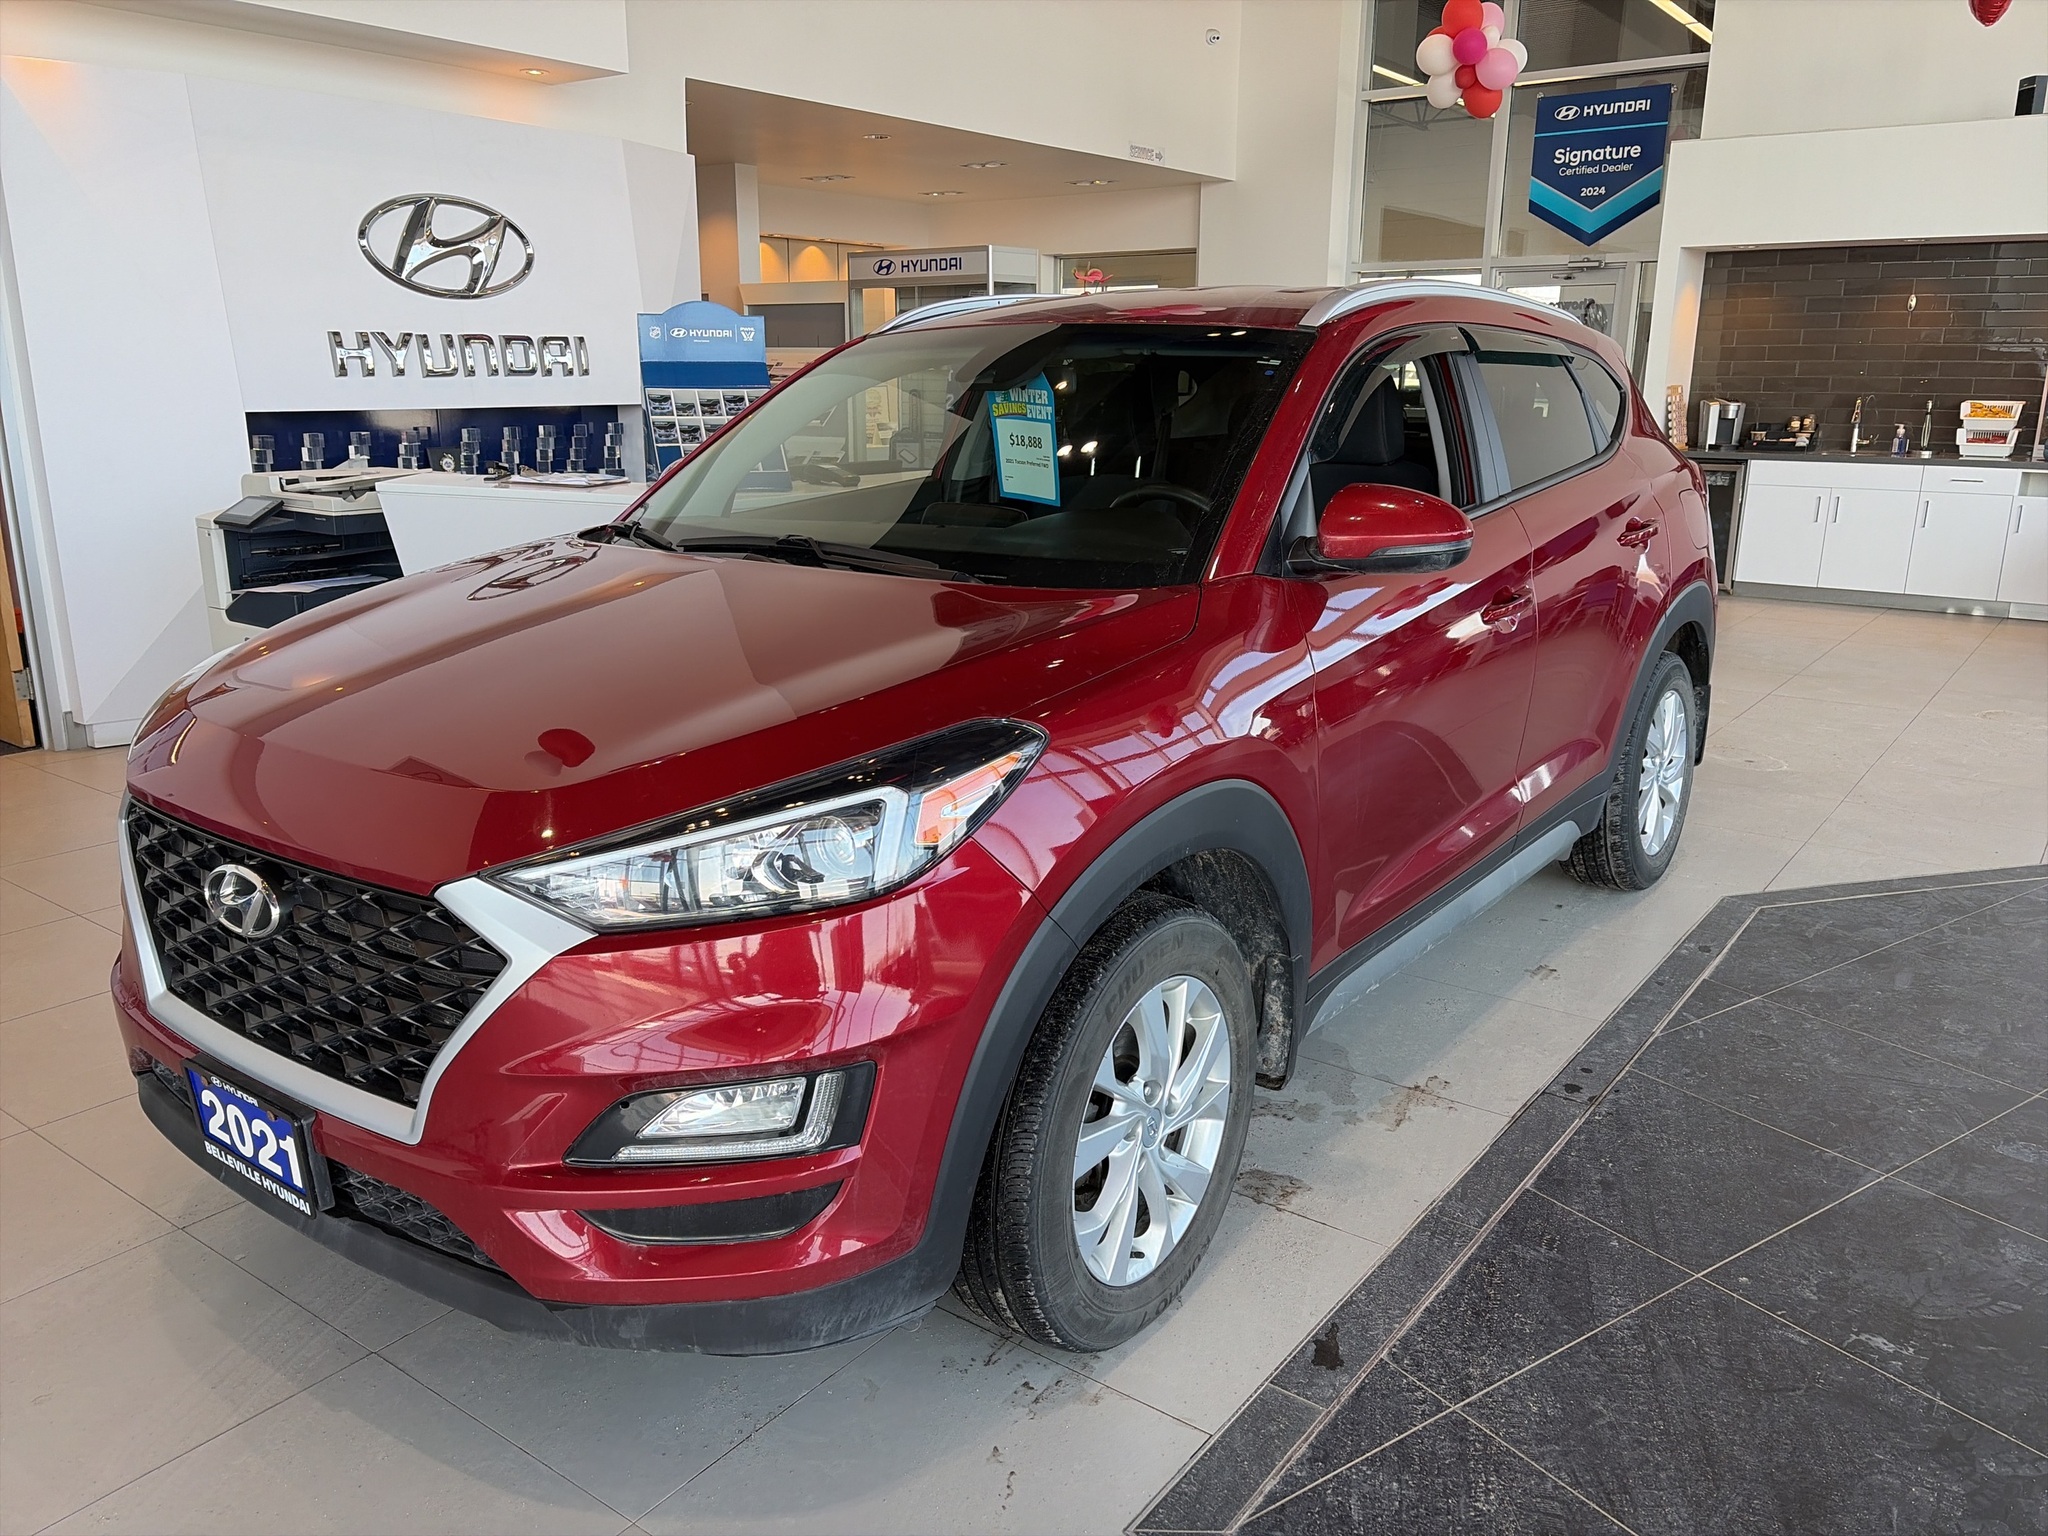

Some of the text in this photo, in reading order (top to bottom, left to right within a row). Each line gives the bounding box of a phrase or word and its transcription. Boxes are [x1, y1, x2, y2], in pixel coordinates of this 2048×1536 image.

[1583, 99, 1651, 117] HYUNDAI
[1553, 144, 1642, 166] Signature
[1558, 162, 1634, 177] Certified Dealer
[1580, 186, 1606, 197] 2024
[901, 257, 963, 274] HYUNDAI
[689, 329, 733, 338] HYUNDAI
[327, 330, 590, 378] HYUNDAI
[1009, 387, 1049, 405] WINTER
[992, 402, 1053, 420] SAVINGS EVENT
[1009, 432, 1043, 450] $18,888
[222, 1082, 259, 1107] HYUNDAI
[201, 1089, 303, 1188] 2021
[204, 1140, 312, 1216] BELLEVILLE HYUNDAI
